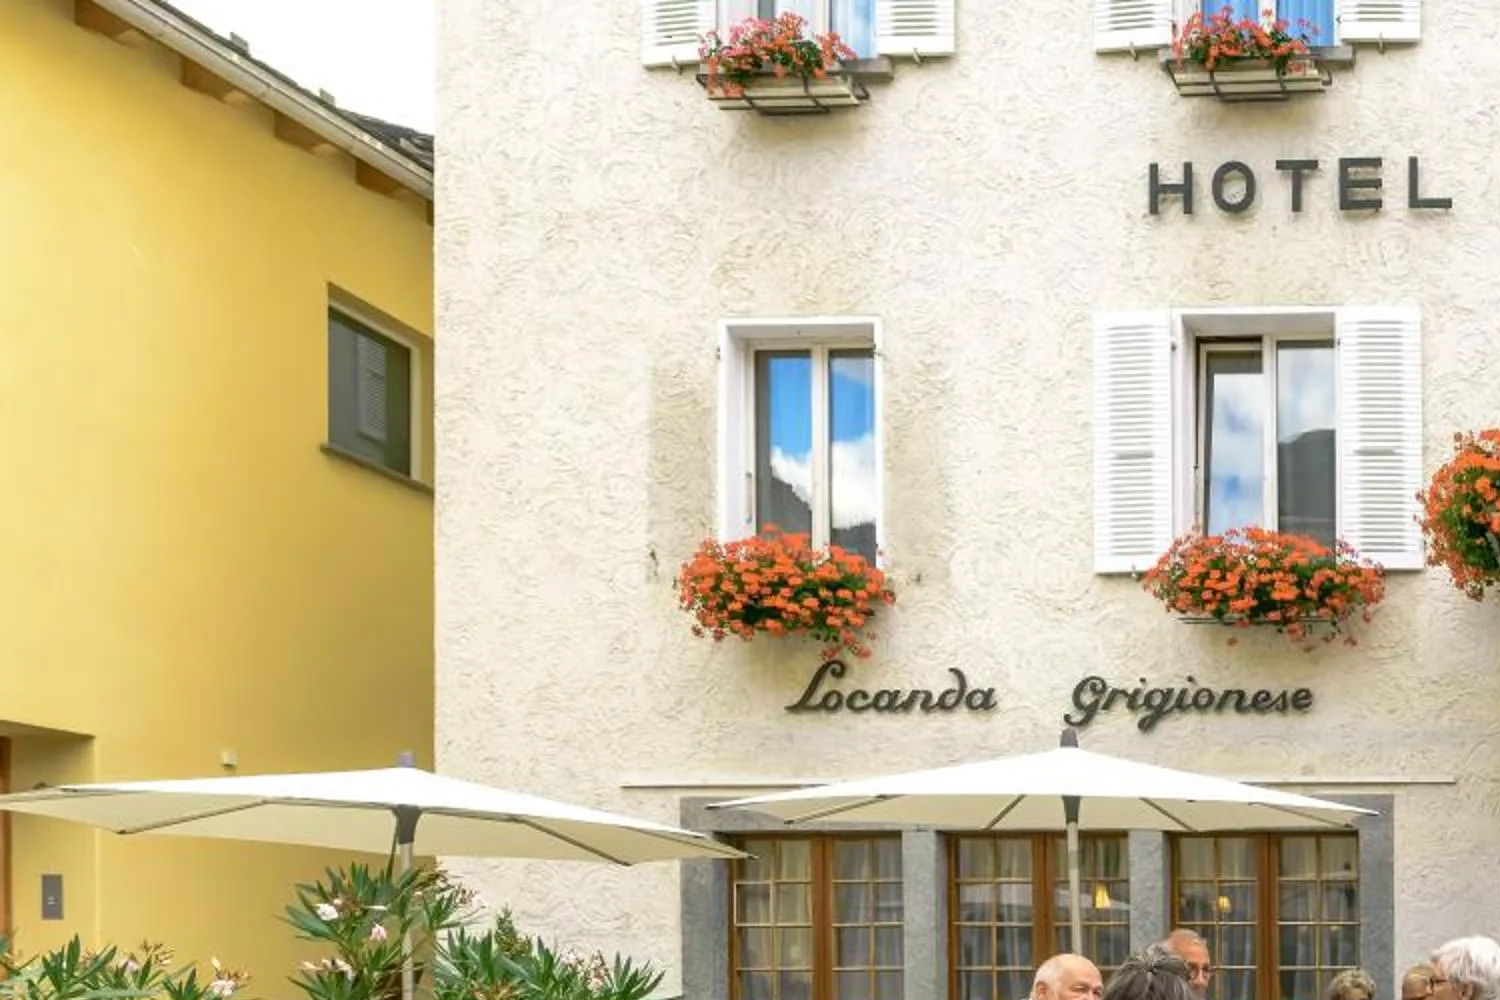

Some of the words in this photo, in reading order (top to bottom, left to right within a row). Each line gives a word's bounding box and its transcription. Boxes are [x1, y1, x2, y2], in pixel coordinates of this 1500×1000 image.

[1149, 157, 1453, 216] HOTEL
[786, 660, 998, 713] Locanda
[1064, 675, 1315, 731] Grigionese
